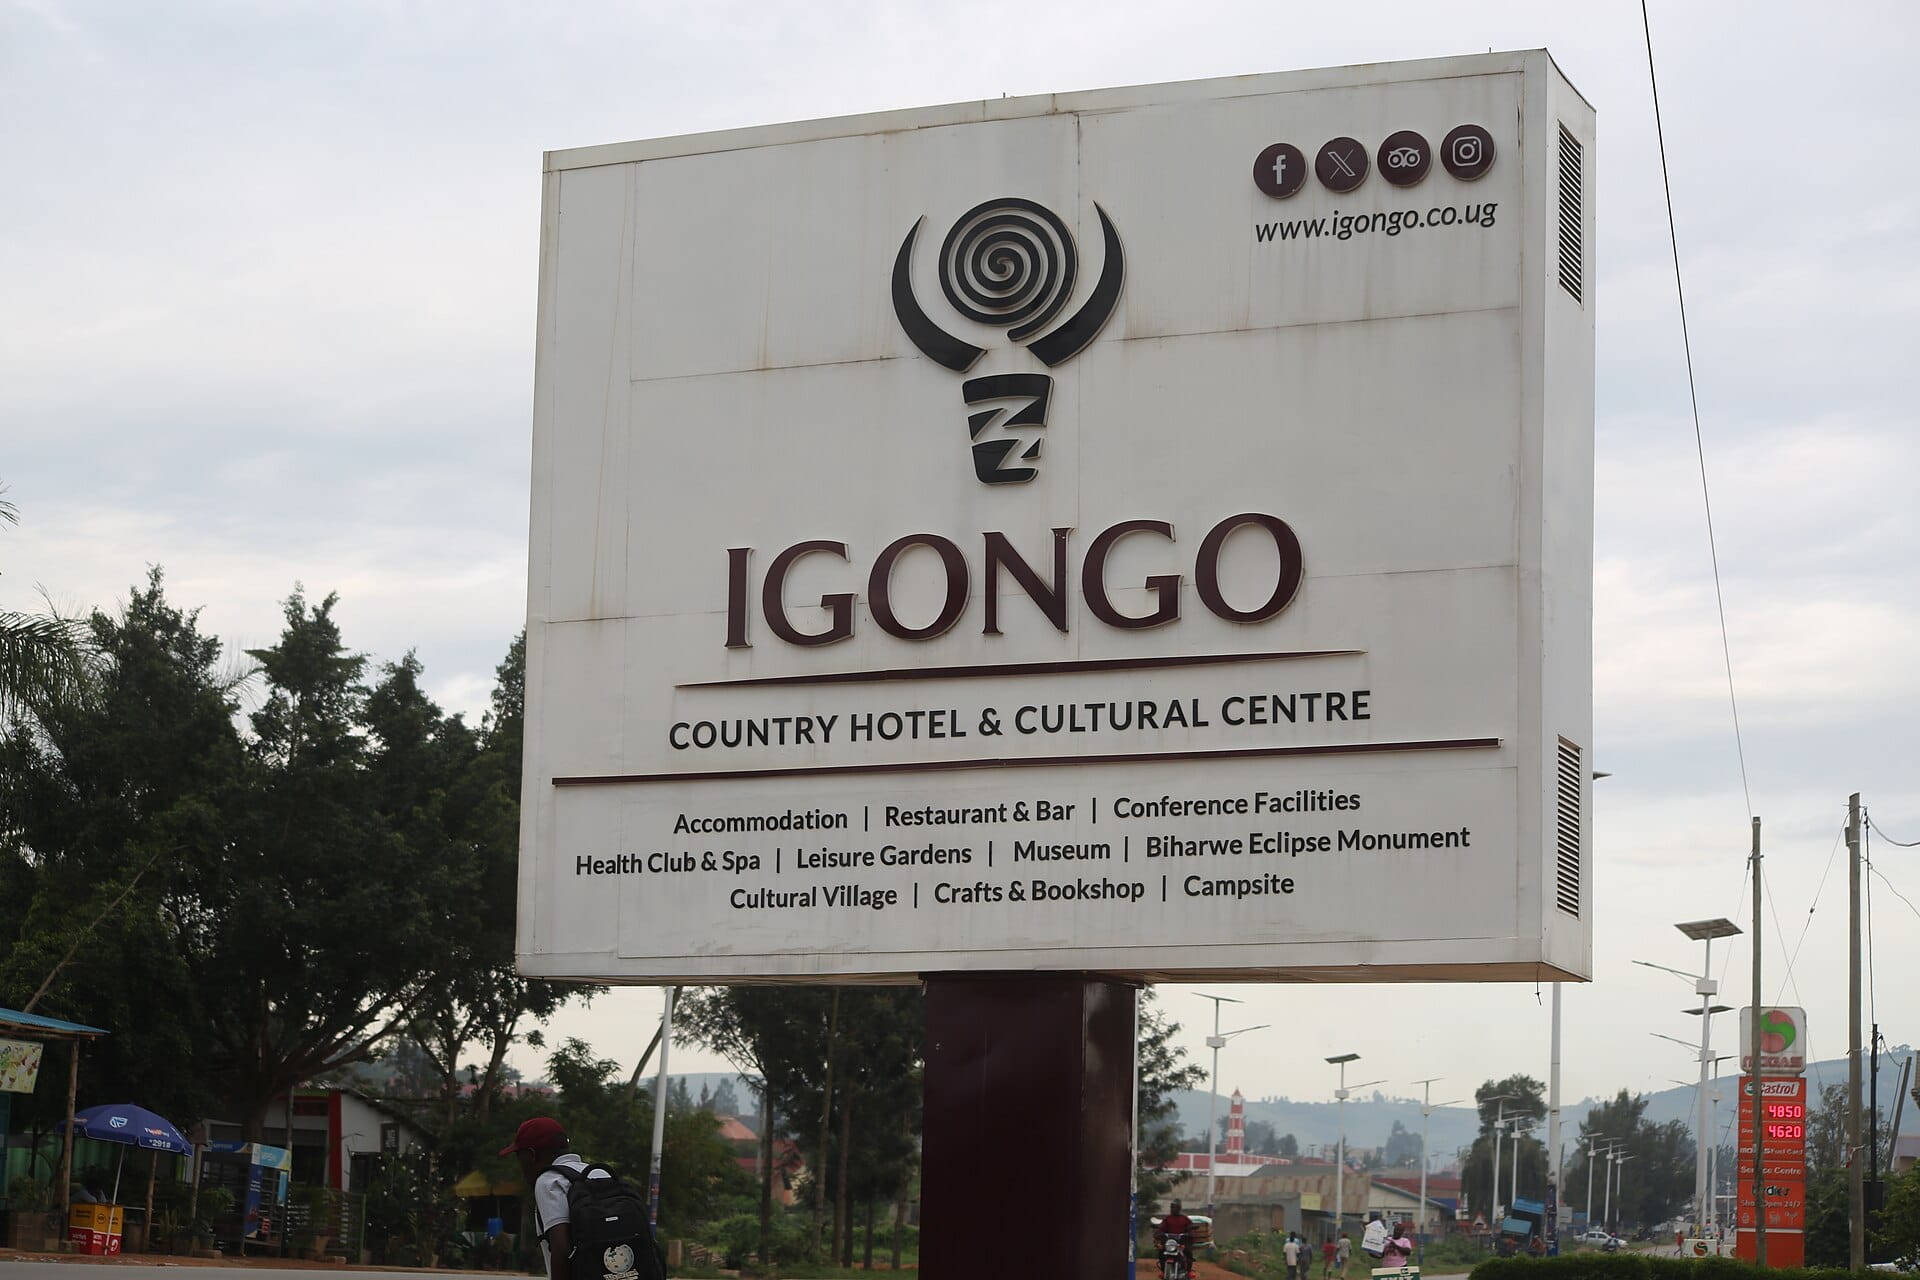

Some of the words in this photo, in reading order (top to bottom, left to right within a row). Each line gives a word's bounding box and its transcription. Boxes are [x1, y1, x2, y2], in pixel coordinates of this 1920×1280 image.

[1255, 202, 1499, 243] www.igongo.co.ug
[724, 512, 1305, 650] IGONGO
[669, 714, 839, 749] COUNTRY
[850, 708, 967, 742] HOTEL
[978, 707, 1004, 737] &
[1014, 696, 1210, 735] CULTURAL
[1221, 690, 1371, 726] CENTRE
[672, 808, 848, 835] Accommodation
[885, 803, 1008, 827] Restaurant
[1012, 801, 1031, 821] &
[1036, 799, 1076, 821] Bar
[1113, 795, 1249, 819] Conference
[1254, 789, 1361, 814] Facilities
[576, 853, 643, 876] Health
[647, 849, 697, 874] Club
[700, 850, 718, 872] &
[721, 850, 761, 875] Spa
[797, 846, 875, 869] Leisure
[879, 843, 972, 866] Gardens
[1014, 840, 1111, 862] Museum
[1146, 831, 1243, 858] Biharwe
[1249, 831, 1332, 857] Eclipse
[1337, 826, 1471, 852] Monument
[730, 887, 817, 910] Cultural
[821, 884, 898, 911] Village
[934, 881, 1003, 904] Crafts
[1008, 880, 1027, 902] &
[1031, 877, 1145, 903] Bookshop
[1183, 872, 1295, 900] Campsite
[1768, 1105, 1801, 1118] 4850
[1768, 1125, 1801, 1138] 4620
